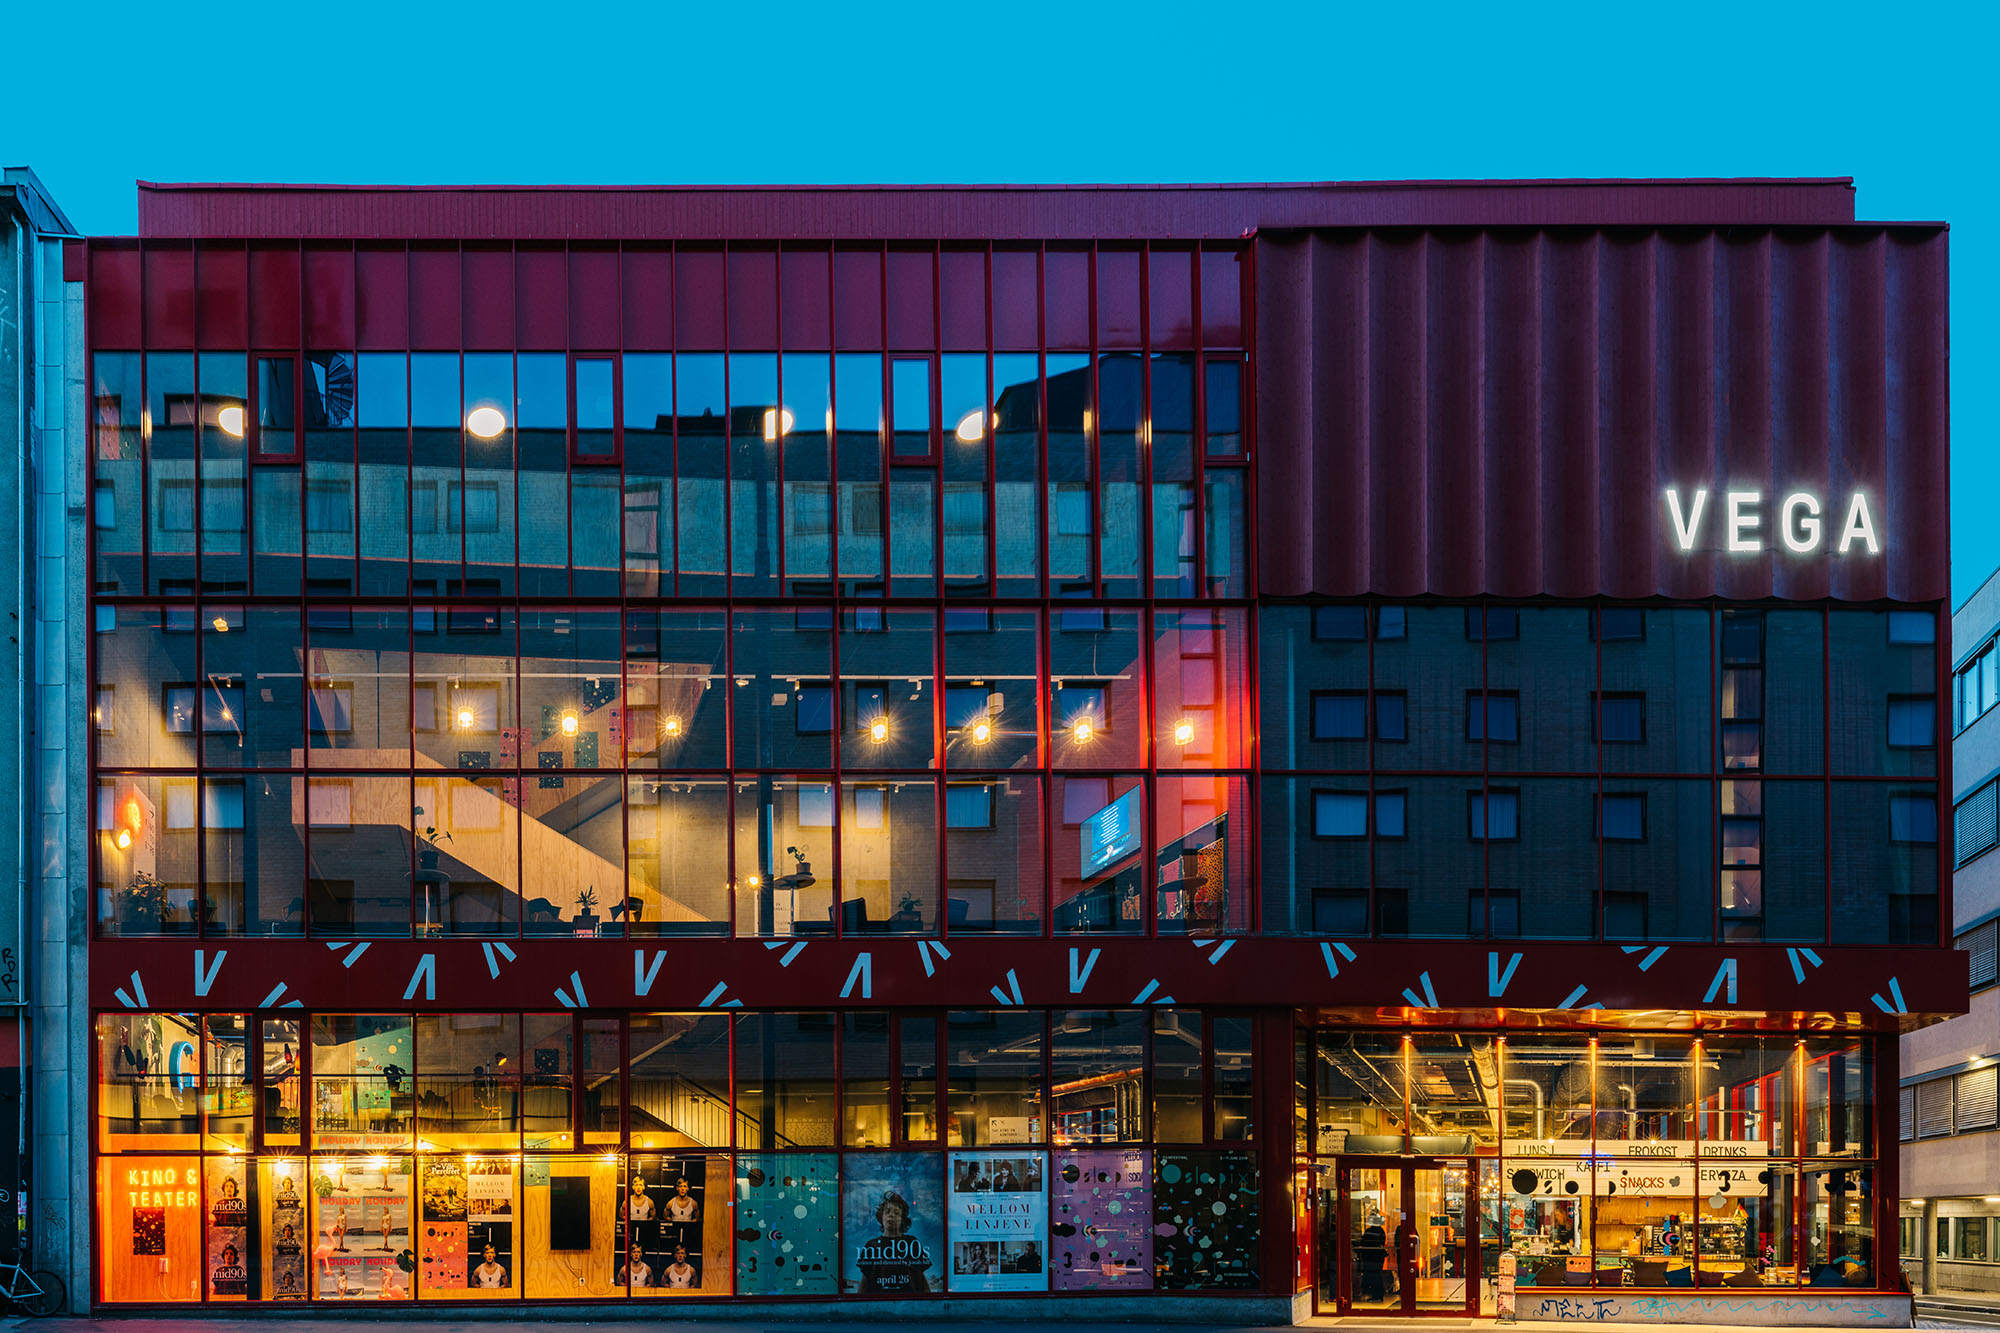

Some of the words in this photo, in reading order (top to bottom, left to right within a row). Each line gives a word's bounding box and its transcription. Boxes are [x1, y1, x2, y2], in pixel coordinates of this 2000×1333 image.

[1666, 489, 1880, 554] VEGA
[321, 1136, 361, 1145] HOLIDAY
[365, 1136, 406, 1145] HOLIDAY
[1628, 1146, 1678, 1156] FROKOST
[1703, 1146, 1747, 1157] DRINKS
[1576, 1161, 1612, 1173] KAFI
[129, 1169, 177, 1186] KINO
[186, 1168, 197, 1185] &
[1620, 1177, 1665, 1188] SNACKS
[129, 1191, 198, 1208] TEATER
[321, 1197, 361, 1206] HOLIDAY
[365, 1197, 406, 1206] HOLIDAY
[966, 1203, 1031, 1214] MELLOM
[965, 1219, 1032, 1230] LINJENE
[856, 1239, 931, 1261] mid90s
[366, 1258, 398, 1267] HOLIDA
[876, 1275, 897, 1286] april
[898, 1274, 910, 1284] 26
